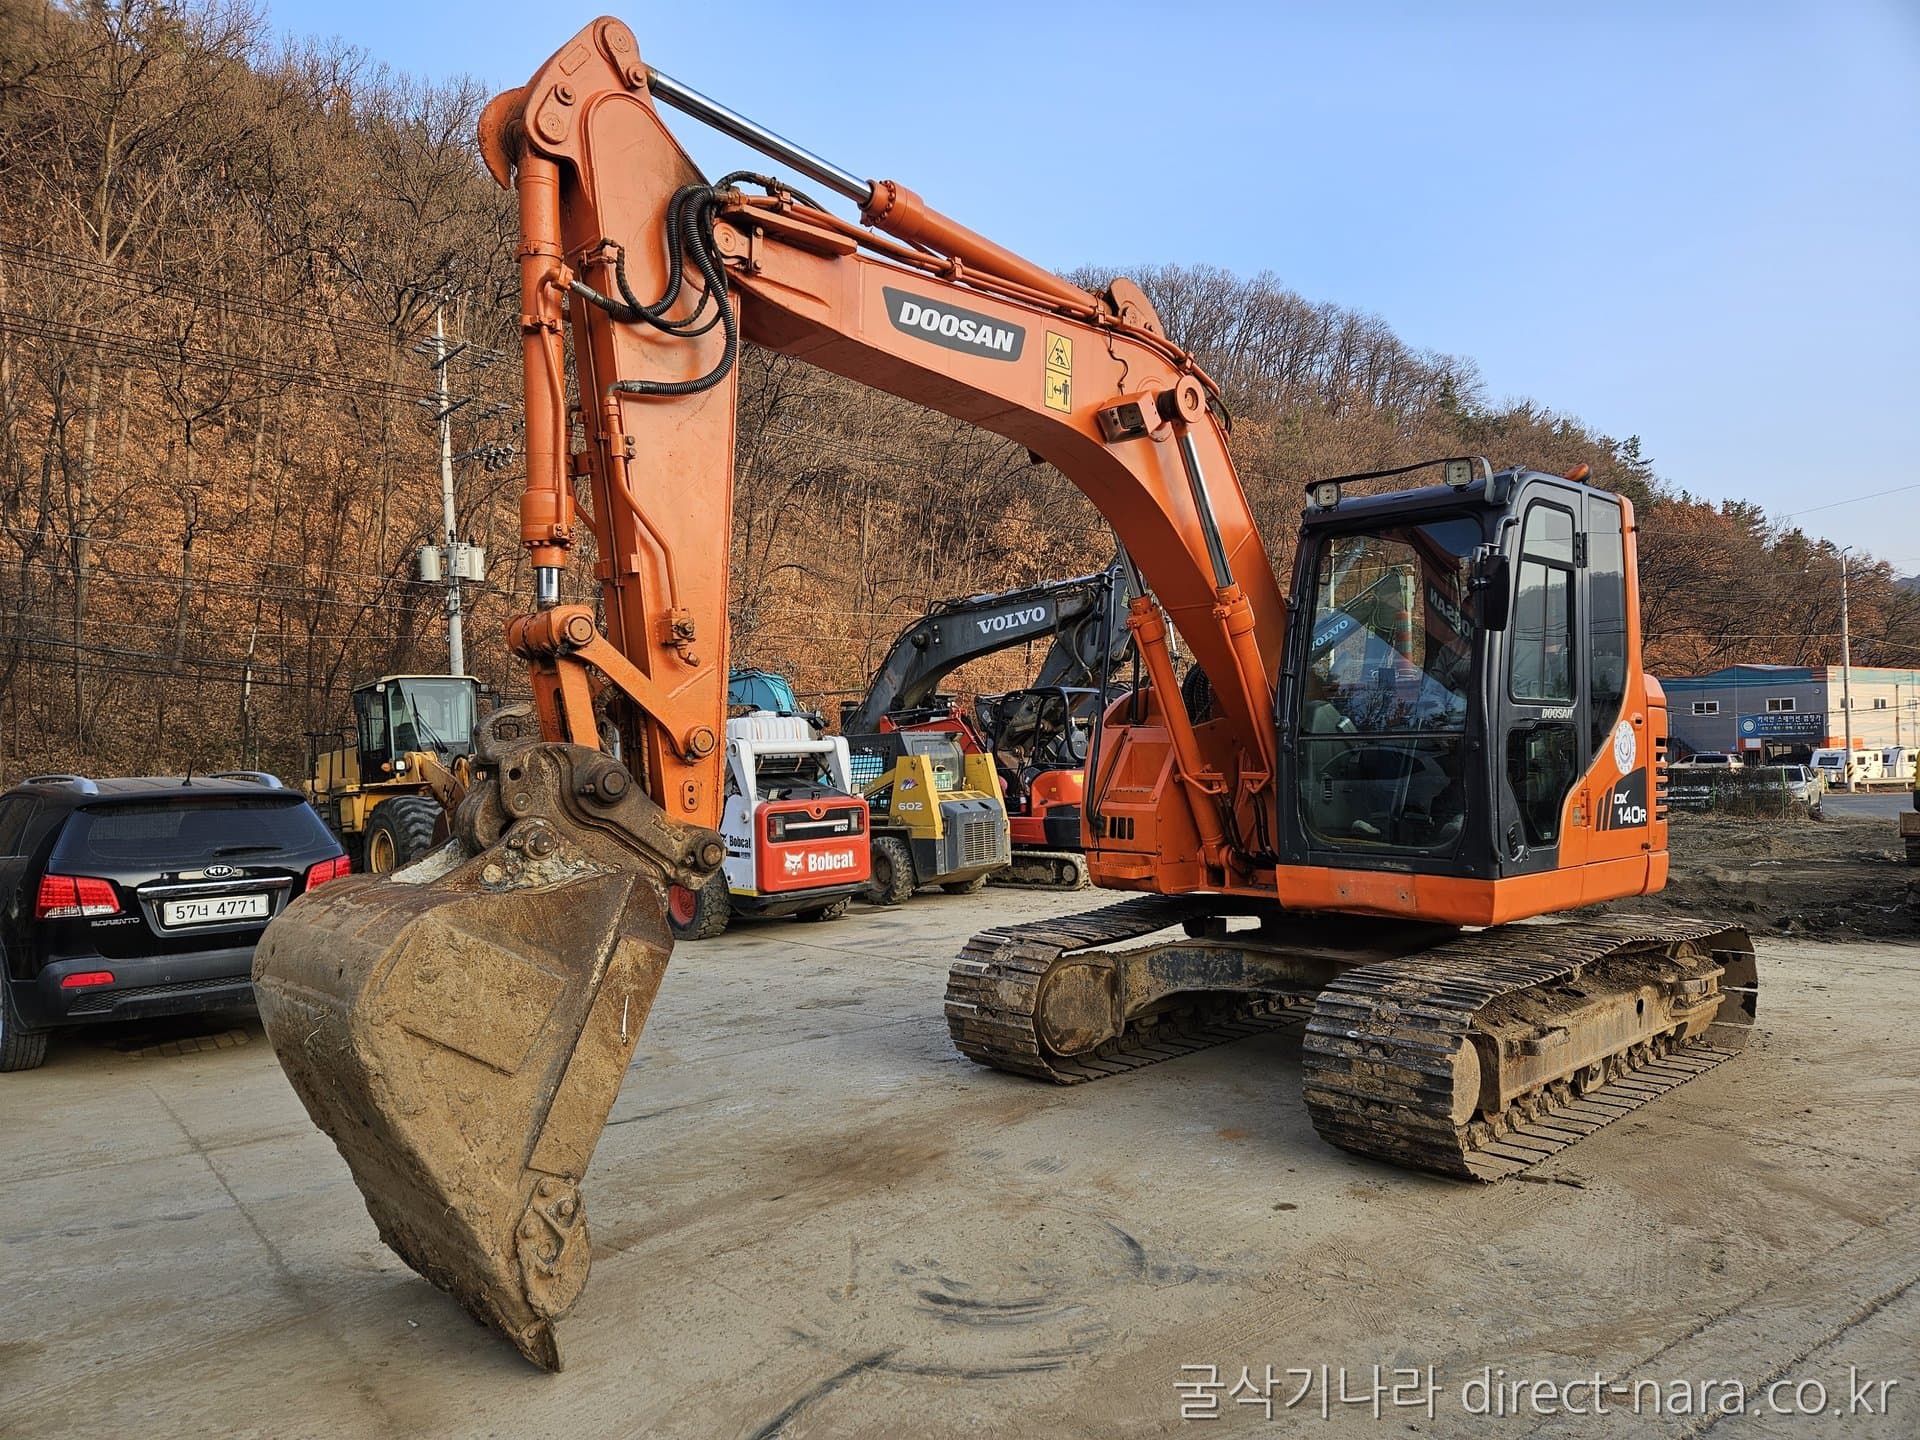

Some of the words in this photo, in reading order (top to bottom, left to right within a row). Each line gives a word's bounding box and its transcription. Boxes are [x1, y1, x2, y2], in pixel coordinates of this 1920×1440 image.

[899, 301, 1015, 353] DOOSAN
[977, 606, 1046, 634] VOLVO
[1541, 708, 1574, 719] DOOSAN
[1614, 790, 1631, 805] DX
[898, 802, 923, 811] 602
[1618, 806, 1647, 825] 140R
[729, 835, 752, 849] Bobcat
[808, 850, 855, 873] Bobcat
[209, 867, 229, 876] KIA
[175, 903, 209, 920] 57너
[217, 899, 257, 917] 4771
